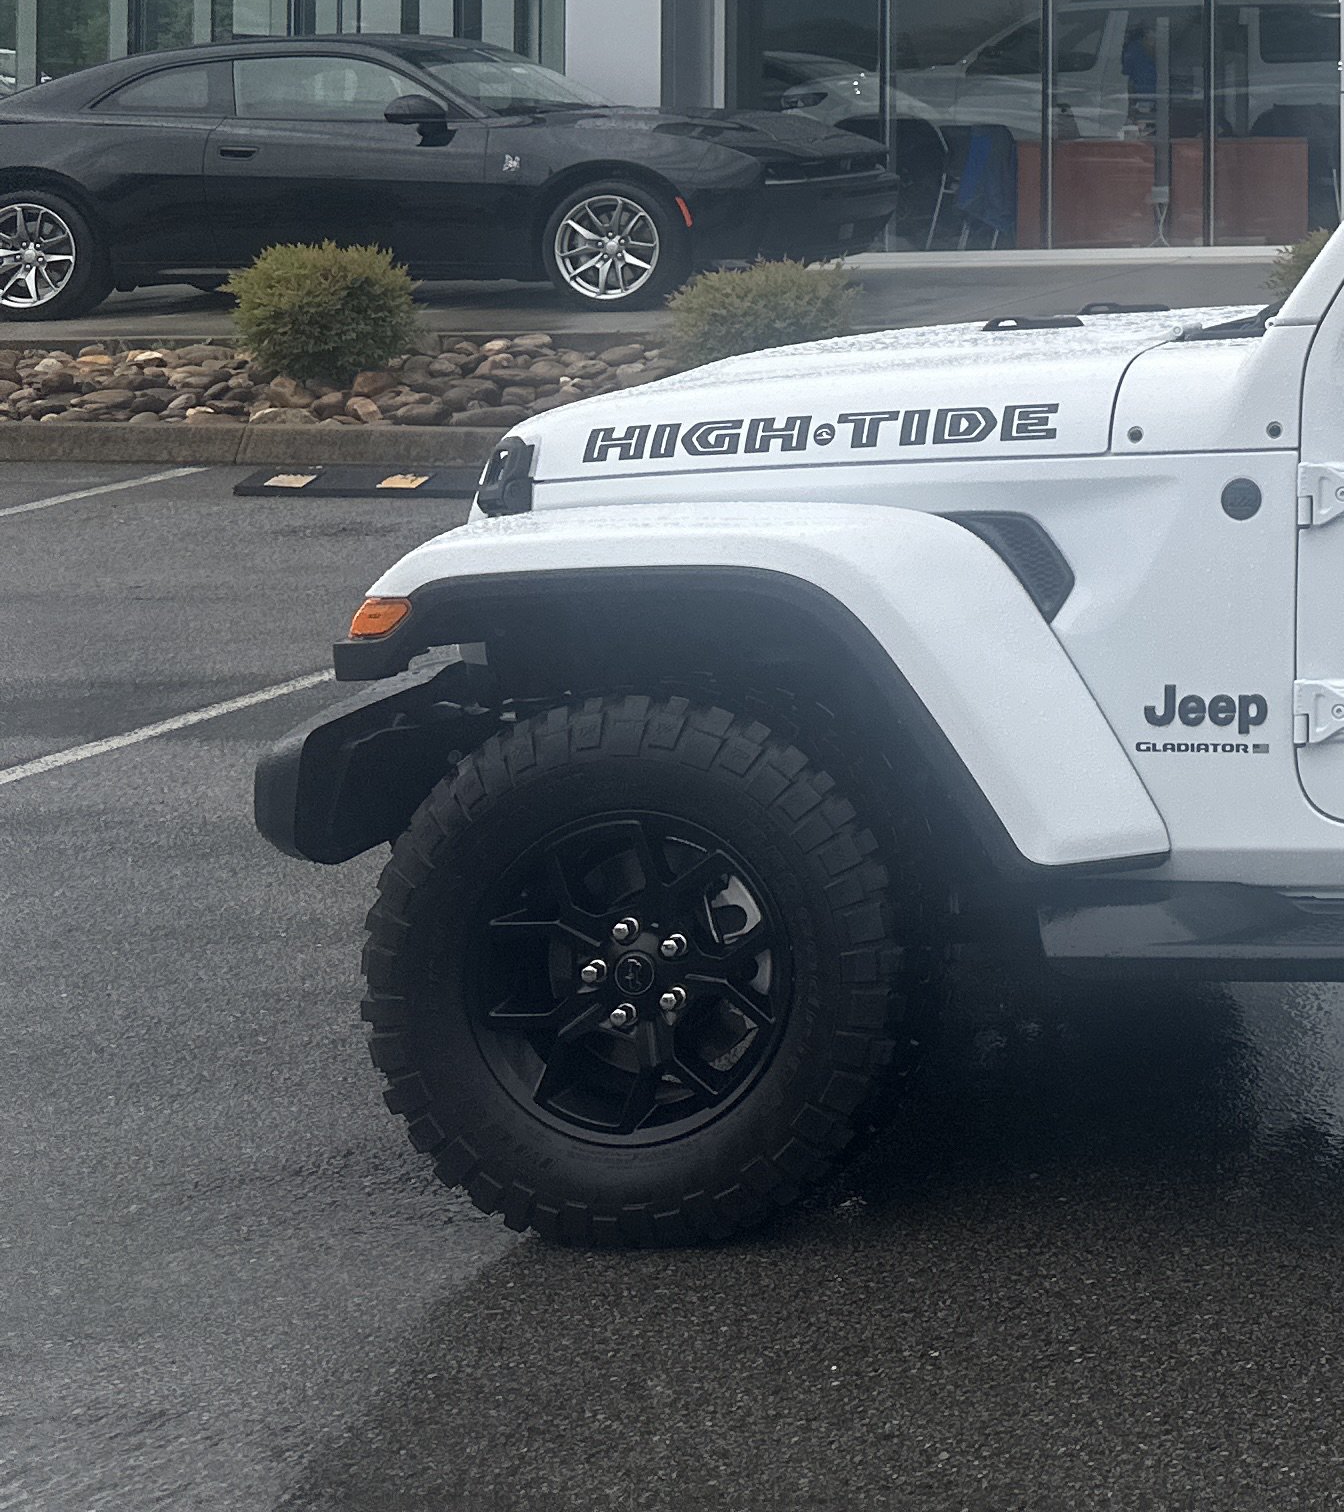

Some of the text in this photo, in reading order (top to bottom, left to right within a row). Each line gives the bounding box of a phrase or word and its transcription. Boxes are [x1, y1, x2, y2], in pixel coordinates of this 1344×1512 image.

[581, 403, 1060, 464] HIGH TIDE
[1144, 683, 1269, 735] Jeep
[1135, 741, 1250, 754] GLADIATOR
